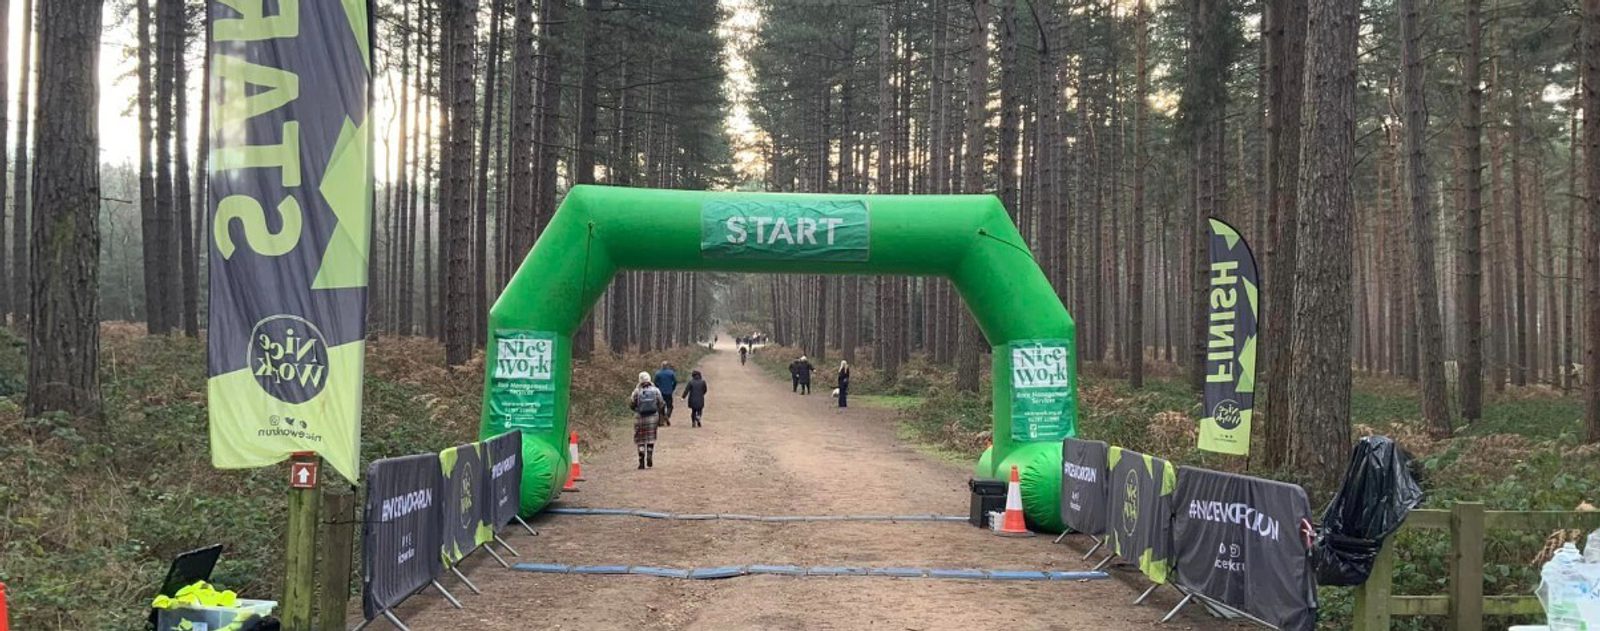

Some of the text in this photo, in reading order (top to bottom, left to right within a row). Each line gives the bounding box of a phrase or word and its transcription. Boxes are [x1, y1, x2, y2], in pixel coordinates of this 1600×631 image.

[726, 215, 844, 246] START
[503, 334, 547, 358] Nice
[1019, 343, 1062, 368] Nice
[498, 354, 550, 377] Work
[1015, 362, 1066, 386] Work
